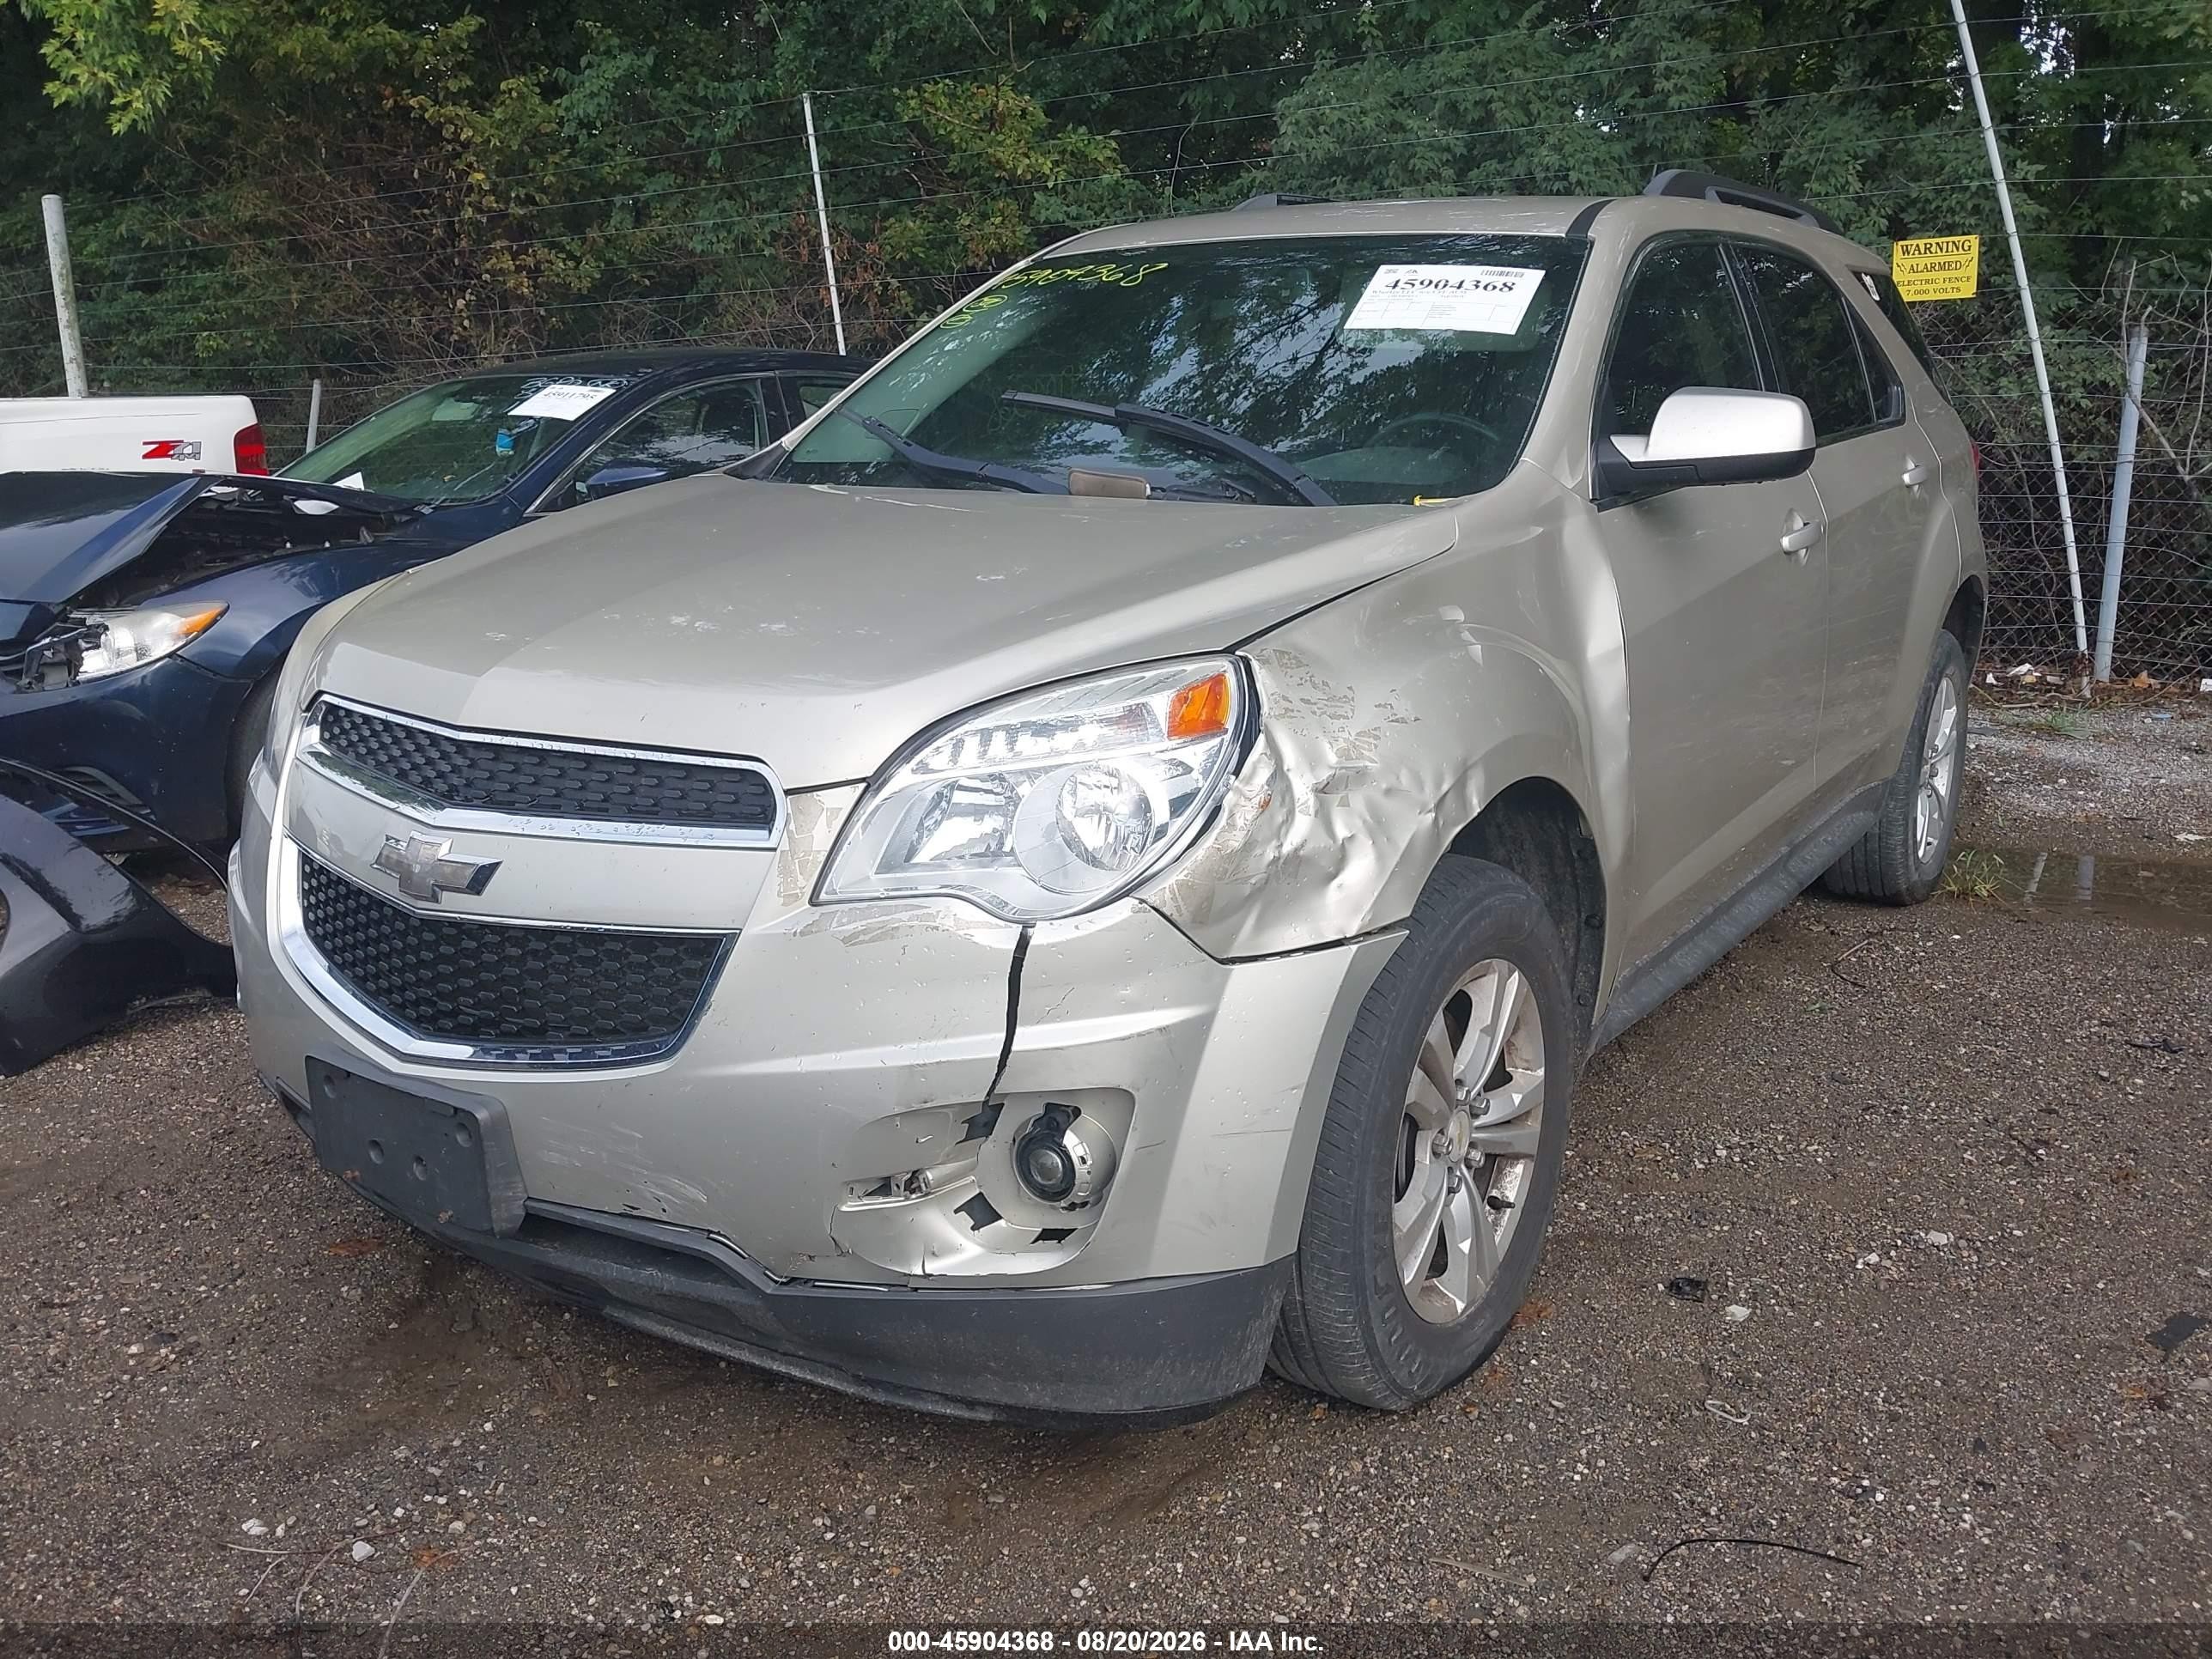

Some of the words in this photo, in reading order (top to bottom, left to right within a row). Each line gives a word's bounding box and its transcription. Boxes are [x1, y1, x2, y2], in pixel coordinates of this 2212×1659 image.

[1899, 240, 1972, 257] WARNING
[1908, 260, 1963, 274] ALARMED
[1385, 278, 1516, 292] 45904368
[1897, 277, 1941, 288] ELECTRIC
[1942, 276, 1972, 284] FENCE
[142, 440, 202, 459] Z71
